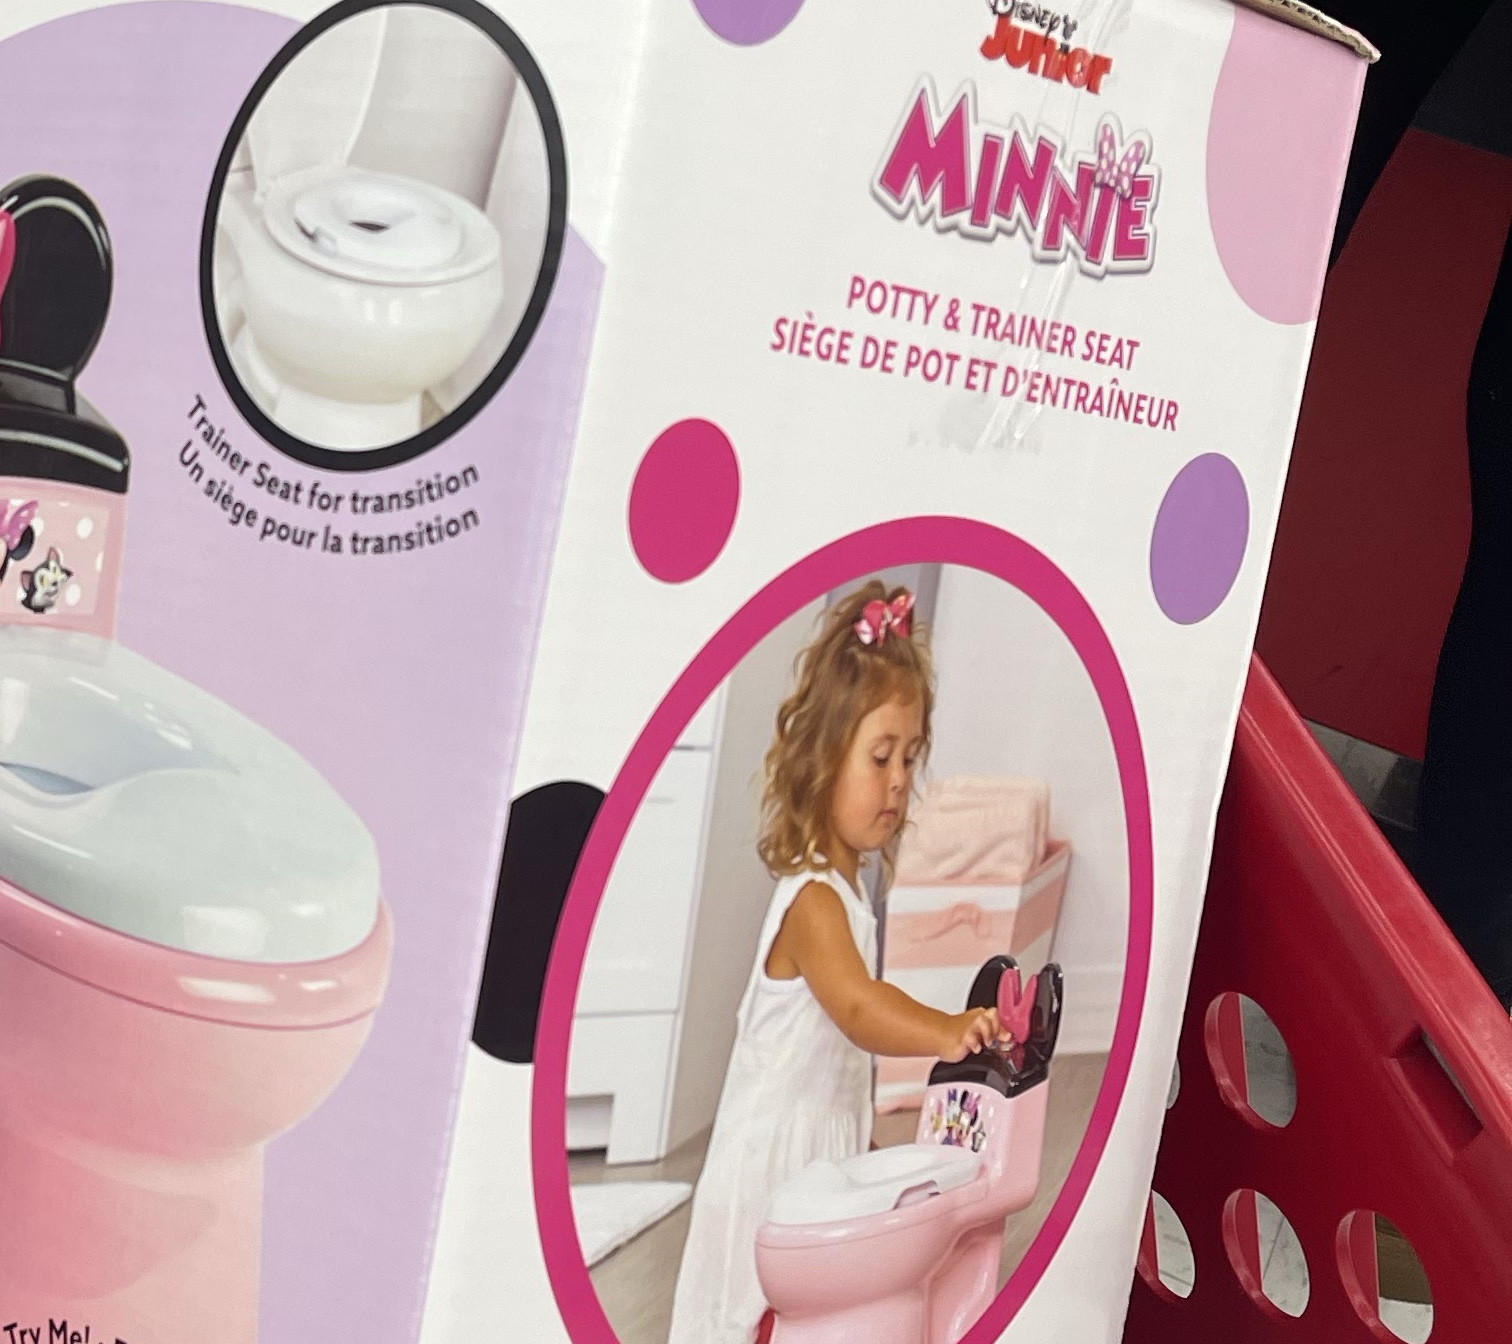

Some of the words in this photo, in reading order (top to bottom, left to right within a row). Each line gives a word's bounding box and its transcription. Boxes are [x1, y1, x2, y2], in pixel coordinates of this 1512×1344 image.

[877, 86, 1155, 268] MINNIE
[770, 310, 854, 365] SIÈGE
[860, 336, 896, 373] DE
[903, 345, 961, 385] POT
[964, 357, 998, 393] ET
[846, 275, 940, 325] POTTY
[943, 297, 961, 332] &
[970, 302, 1077, 359] TRAINER
[1080, 330, 1141, 371] SEAT
[178, 439, 205, 484] Un
[203, 476, 258, 528] siège
[259, 514, 319, 549] pour
[321, 524, 344, 554] la
[350, 506, 480, 555] transition
[188, 393, 252, 476] Trainer
[252, 461, 303, 506] Seat
[306, 481, 345, 514] for
[350, 463, 480, 515] transition
